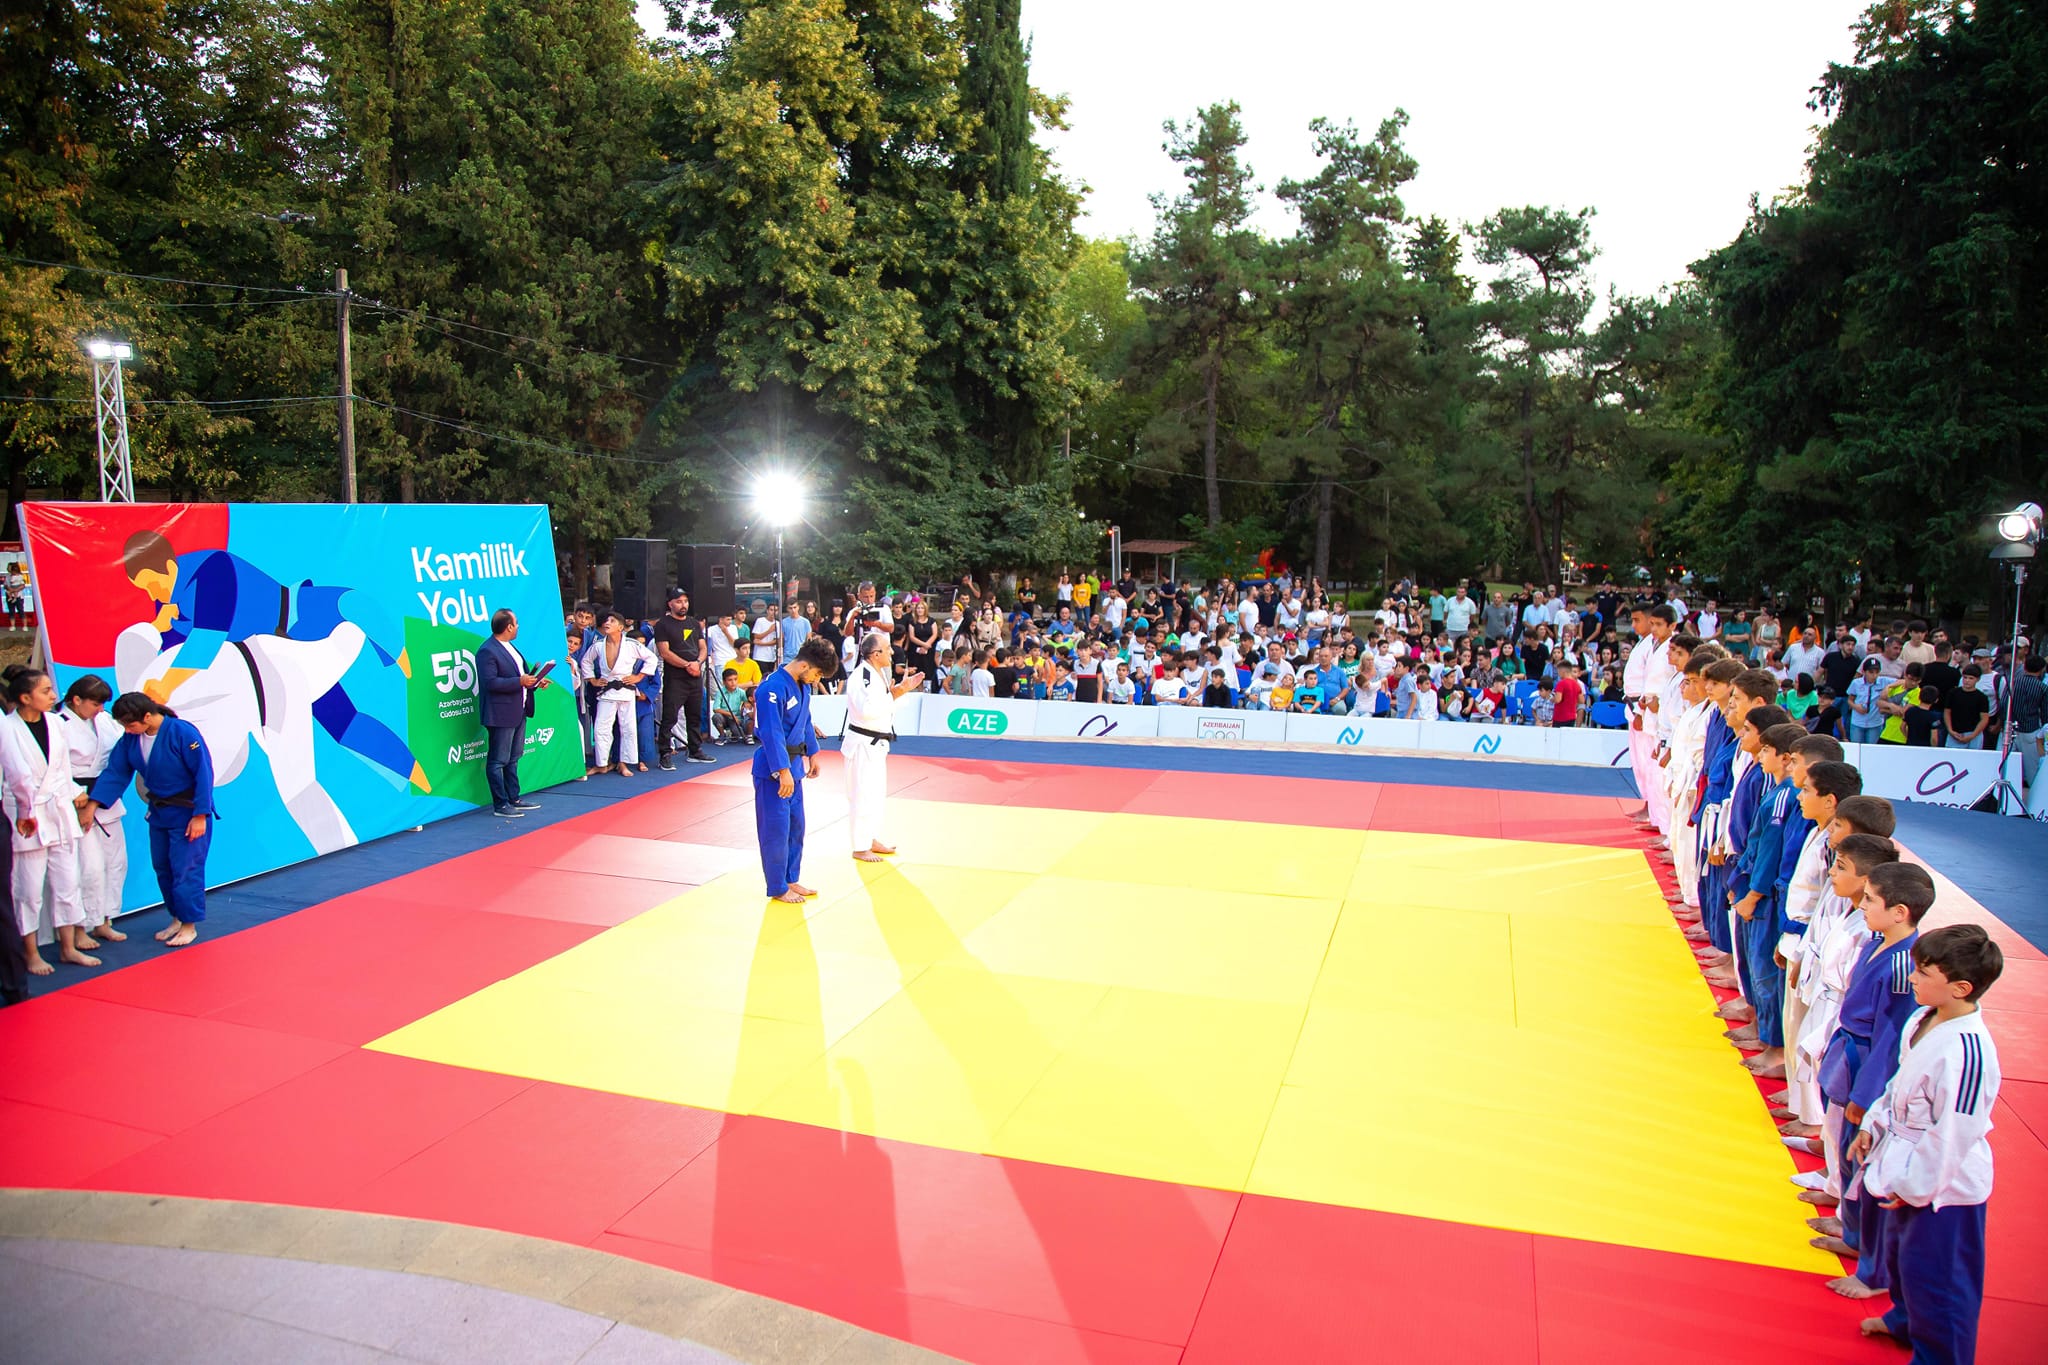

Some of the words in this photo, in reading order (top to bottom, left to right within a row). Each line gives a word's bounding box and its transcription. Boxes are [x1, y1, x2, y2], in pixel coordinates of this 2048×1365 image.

[411, 542, 530, 583] Kamillik
[417, 588, 489, 627] Yolu
[462, 706, 470, 714] 50
[957, 712, 998, 731] AZE
[1202, 721, 1241, 729] AZERBAIJAN
